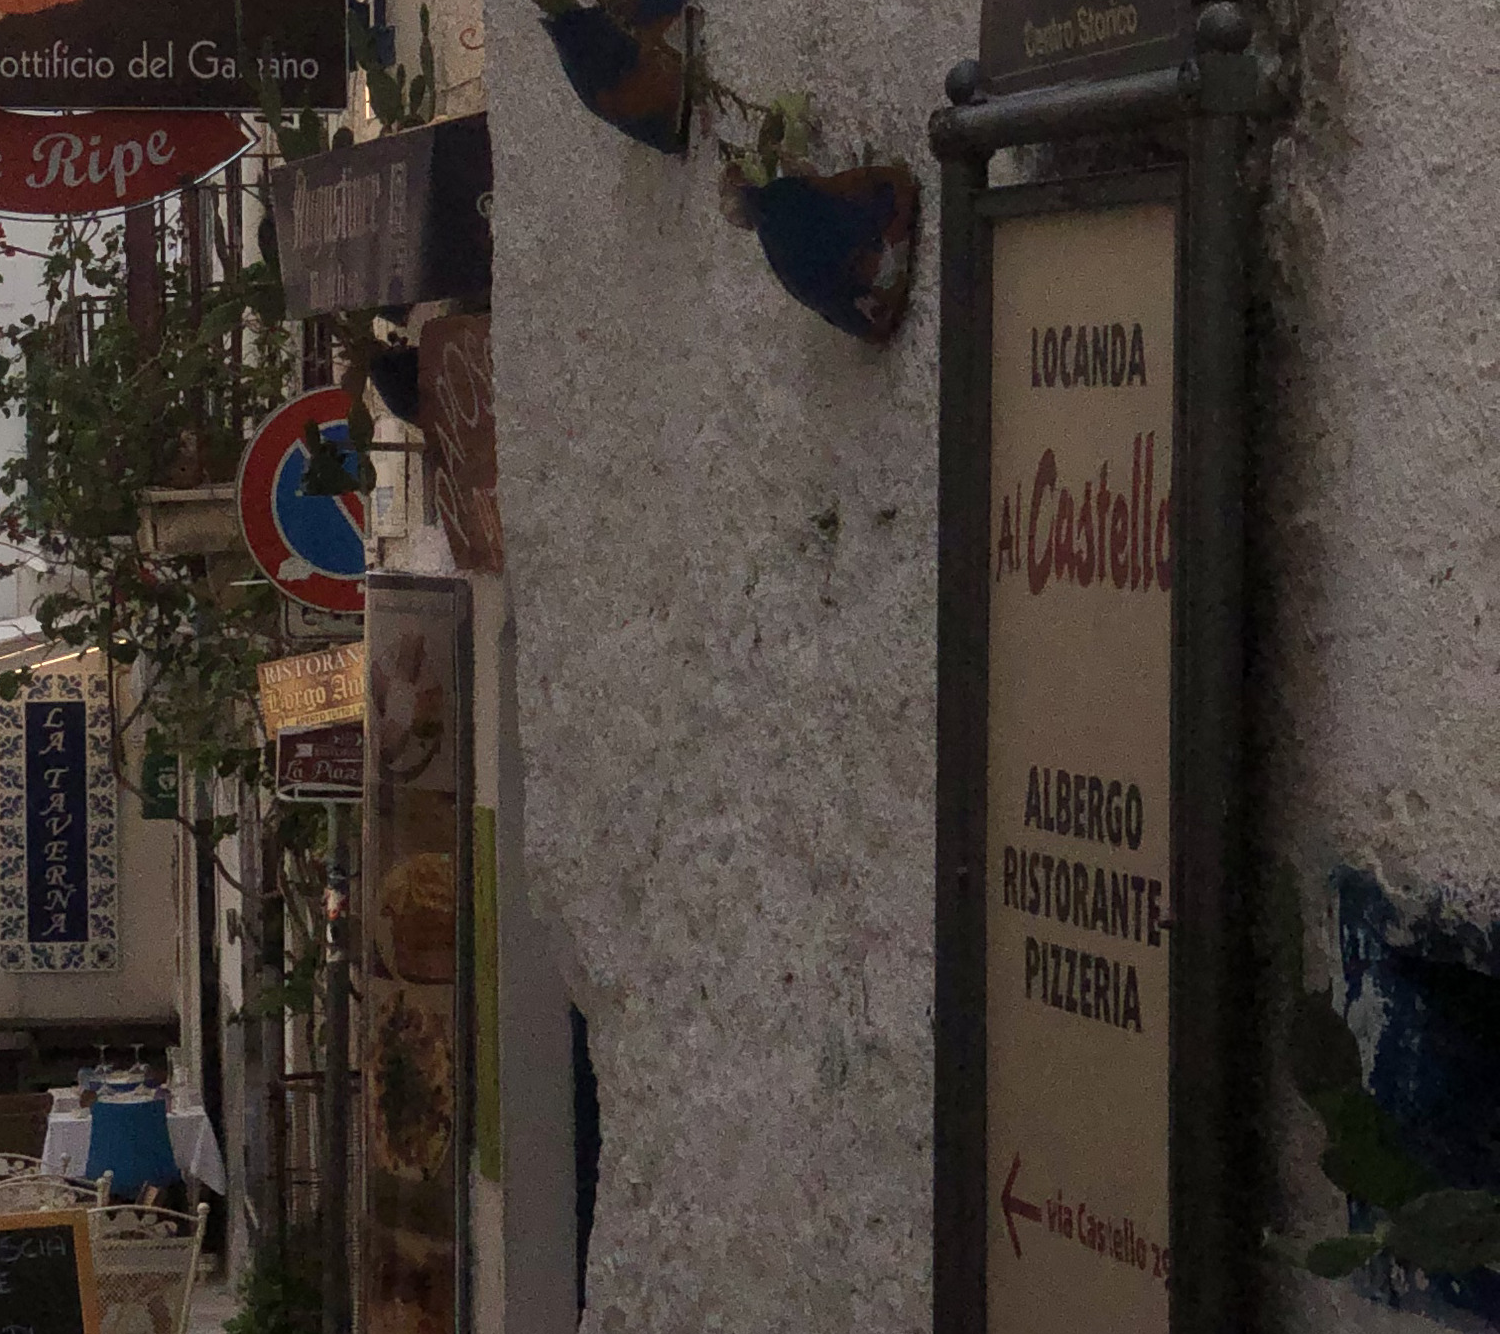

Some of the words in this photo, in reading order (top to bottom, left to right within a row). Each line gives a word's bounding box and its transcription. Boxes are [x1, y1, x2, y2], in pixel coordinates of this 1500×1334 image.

[128, 40, 175, 80] del
[188, 39, 320, 81] Gaano
[25, 127, 176, 198] Ripe
[1030, 322, 1147, 389] LOCANDA
[996, 479, 1022, 583] Al
[39, 707, 67, 756] LA
[266, 685, 327, 714] Borgo
[1023, 764, 1144, 851] ALBERGO
[39, 767, 78, 937] TAVERNA
[1003, 846, 1162, 948] RISTORANTE
[1024, 935, 1143, 1033] PIZZERIA
[1046, 1189, 1074, 1240] via
[1077, 1201, 1147, 1272] Castello
